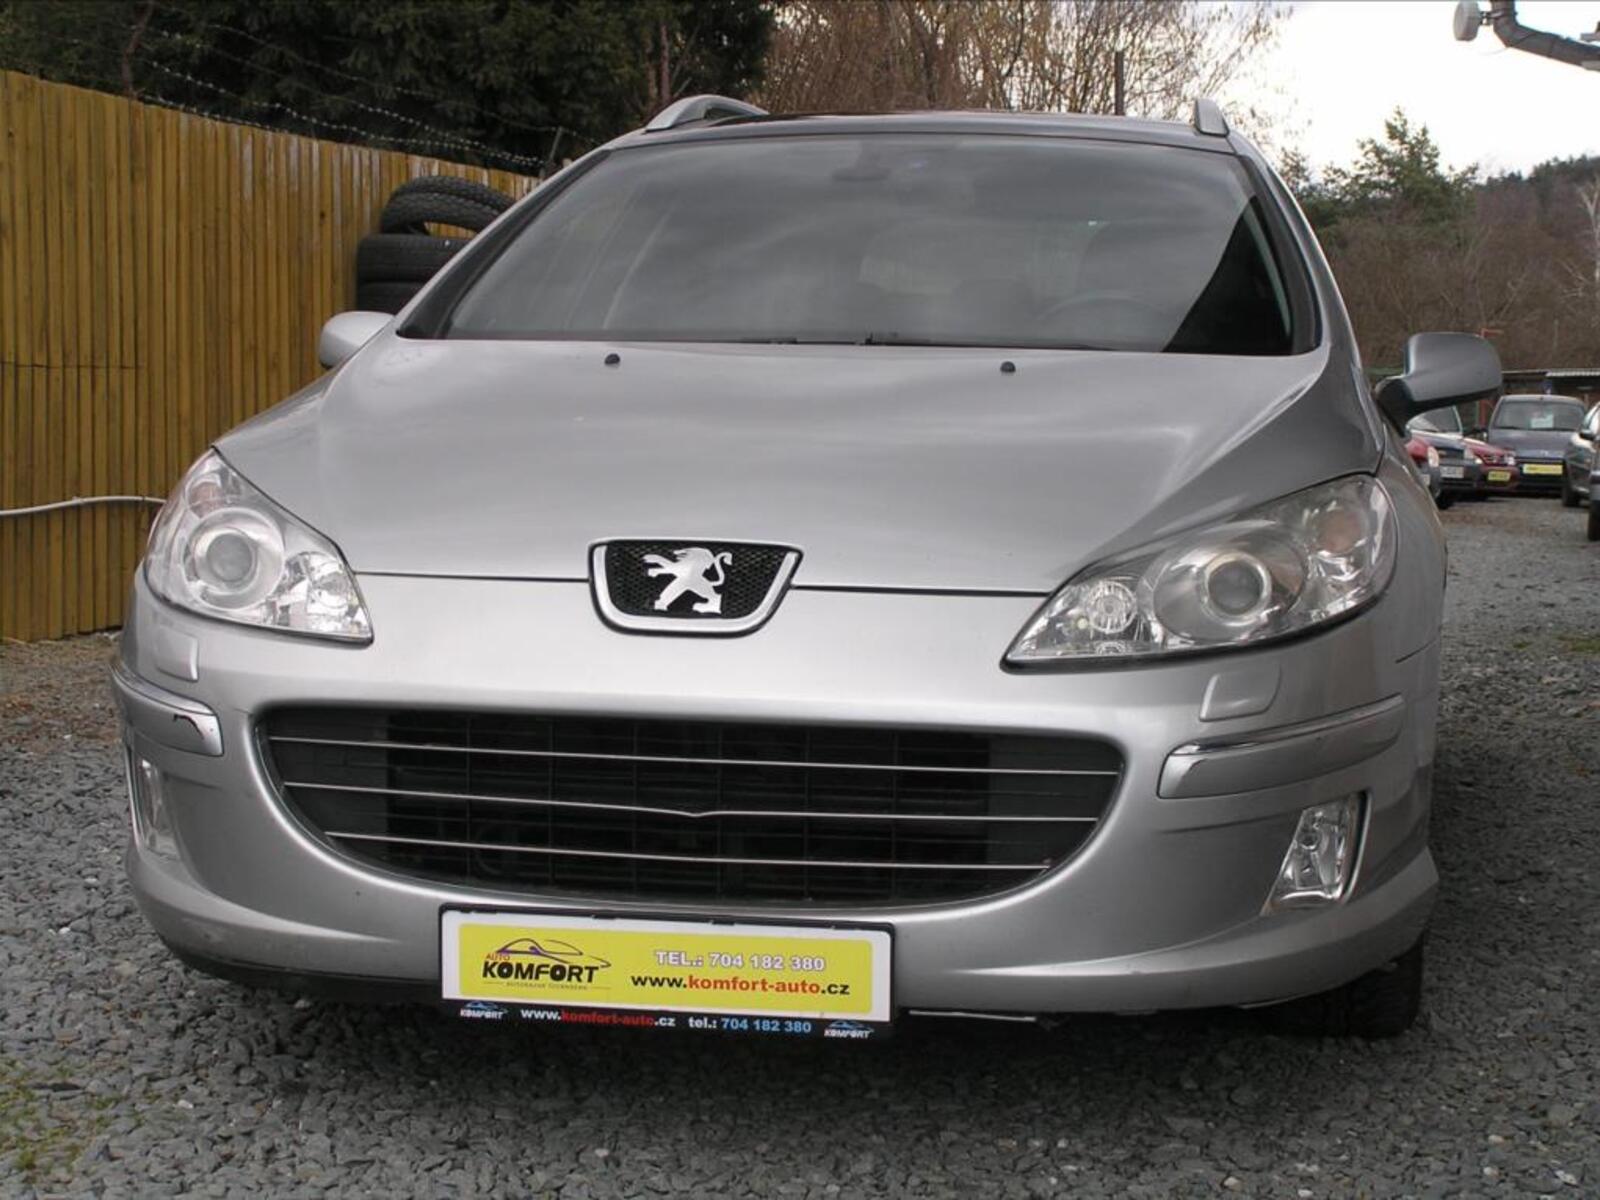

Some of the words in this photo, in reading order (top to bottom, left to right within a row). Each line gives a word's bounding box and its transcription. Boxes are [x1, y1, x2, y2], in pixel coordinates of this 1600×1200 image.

[486, 952, 511, 961] AUTO
[656, 950, 703, 968] TEL.:
[709, 952, 744, 968] 704
[750, 954, 784, 970] 182
[791, 955, 825, 972] 380
[482, 960, 600, 983] KOMFORT
[631, 974, 850, 996] www.komfort-auto.cz
[460, 1008, 504, 1019] KOMFORT
[520, 1008, 676, 1027] www.komfort-auto.cz
[688, 1016, 717, 1029] tel.:
[721, 1018, 749, 1030] 704
[753, 1019, 781, 1032] 182
[784, 1020, 812, 1033] 380
[824, 1028, 871, 1039] KOMFORT
